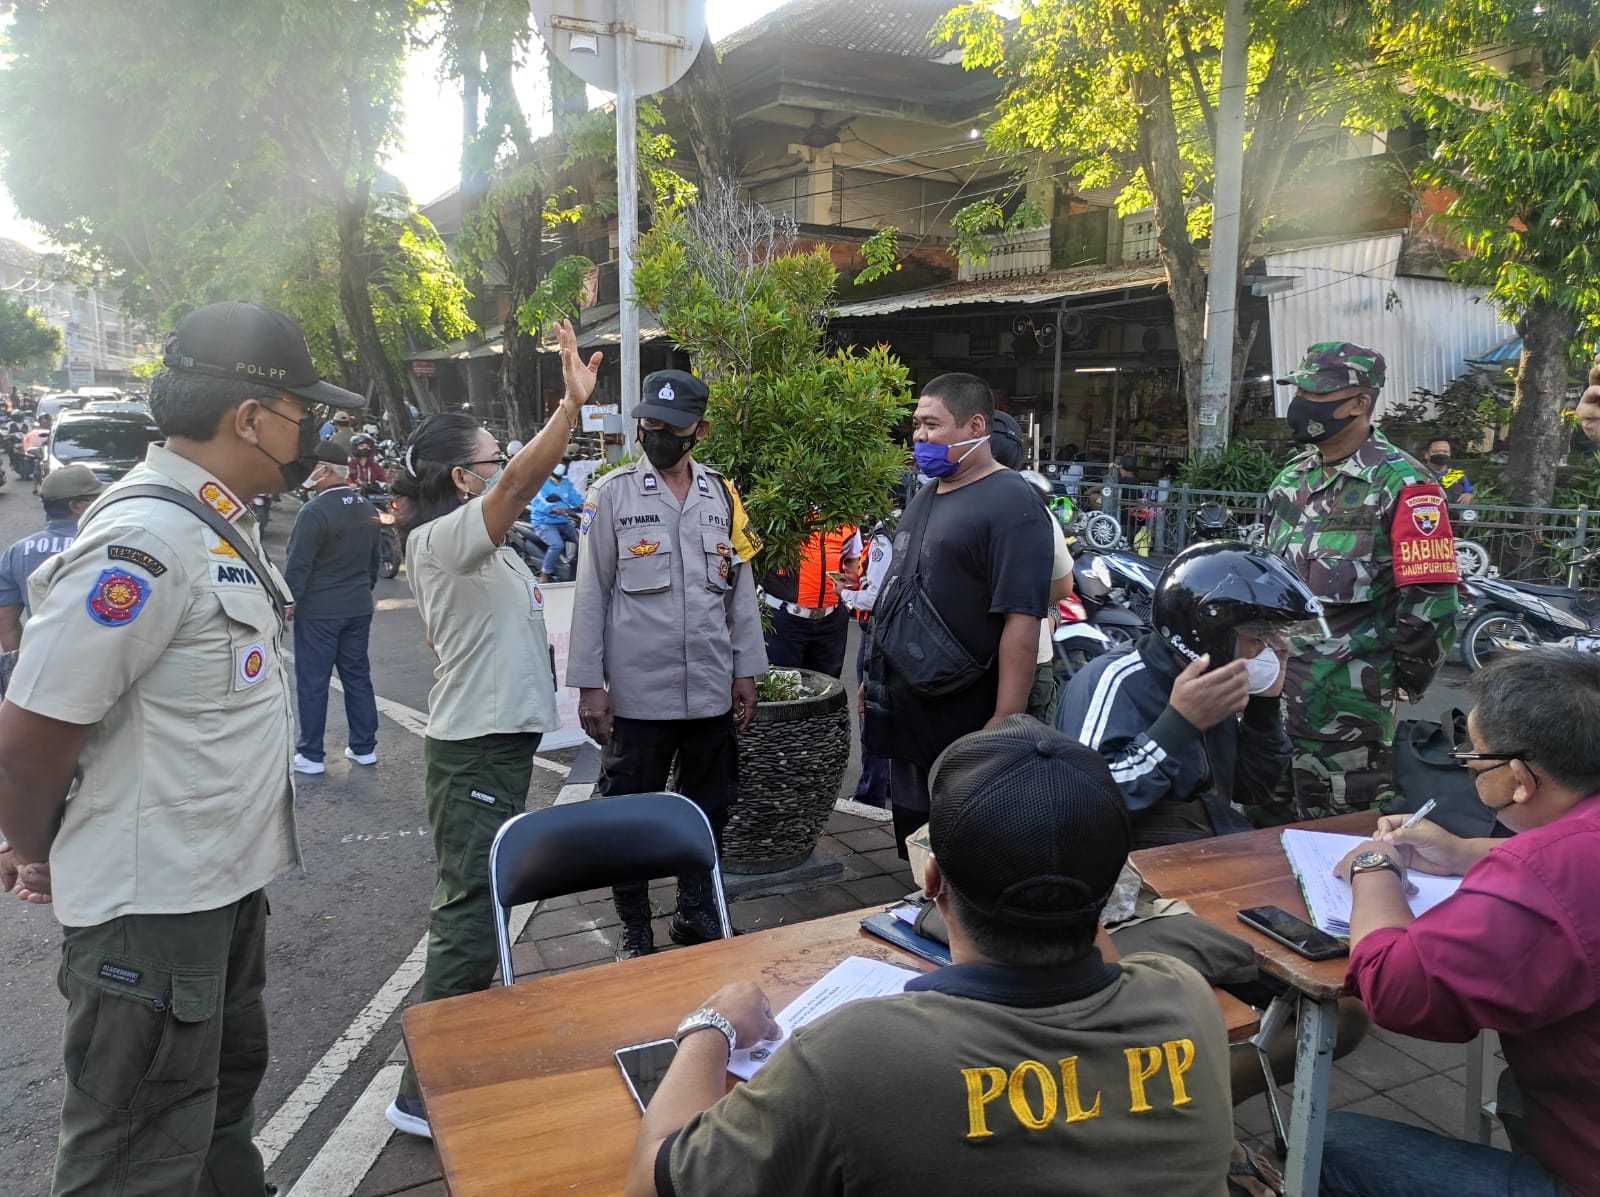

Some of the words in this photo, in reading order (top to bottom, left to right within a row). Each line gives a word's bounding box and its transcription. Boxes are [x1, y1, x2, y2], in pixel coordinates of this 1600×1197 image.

[236, 362, 265, 376] POL
[269, 367, 287, 379] PP
[619, 516, 633, 526] WY
[1400, 537, 1455, 562] BABINSA
[217, 565, 257, 585] ARYA
[960, 1055, 1101, 1139] POL
[1123, 1038, 1195, 1113] PP
